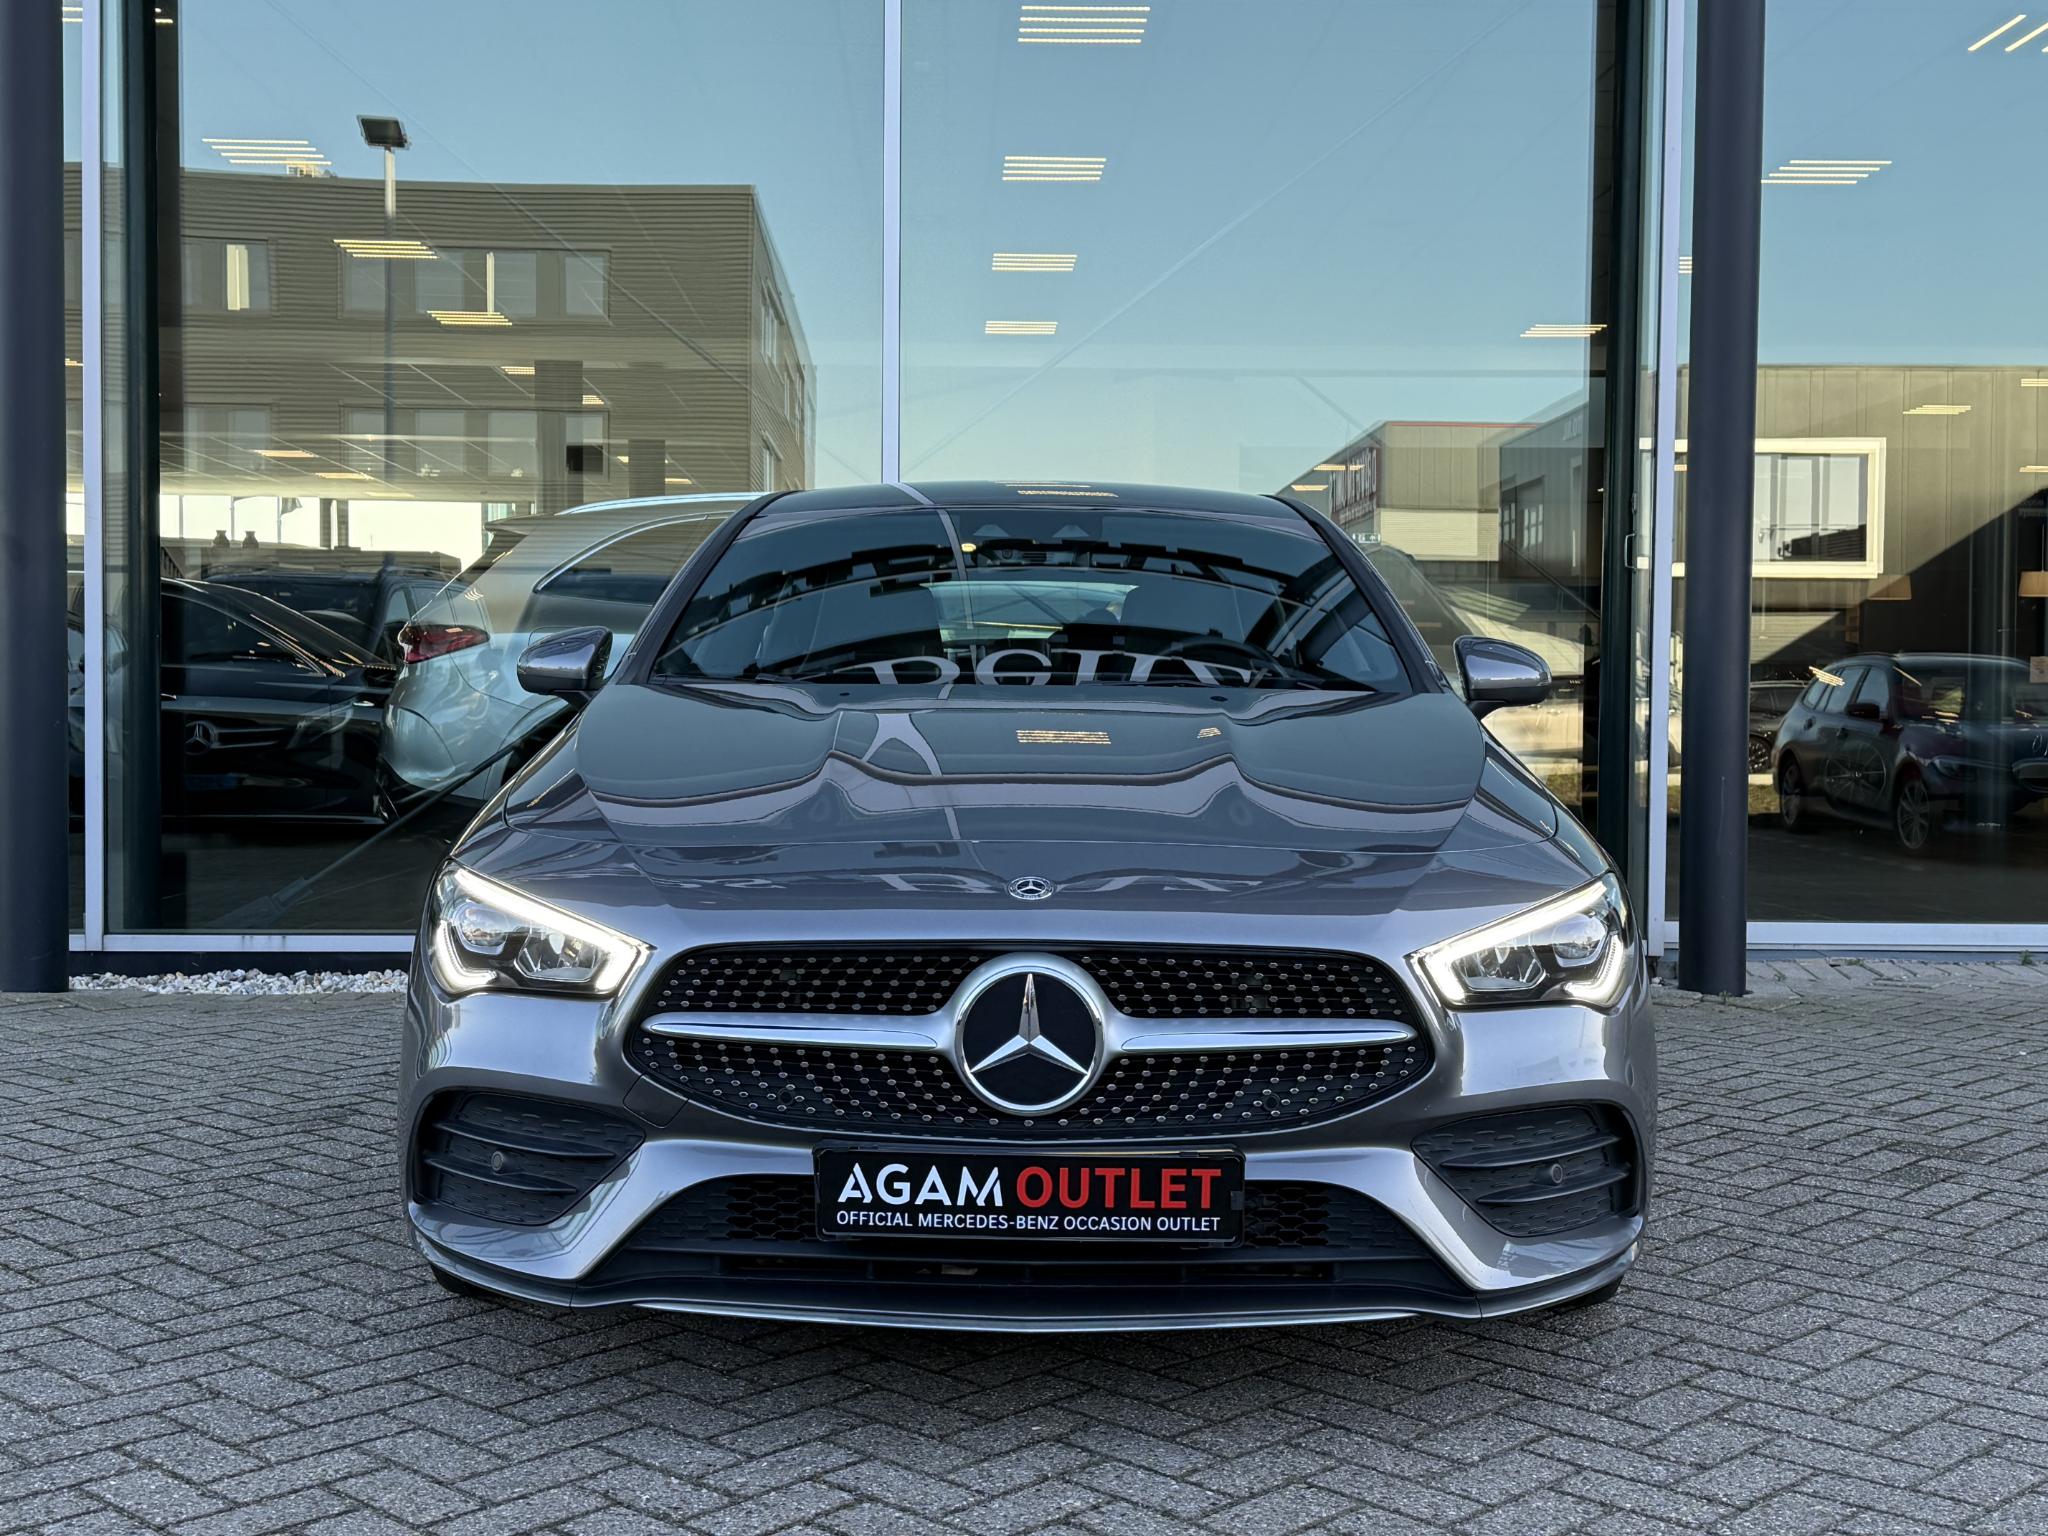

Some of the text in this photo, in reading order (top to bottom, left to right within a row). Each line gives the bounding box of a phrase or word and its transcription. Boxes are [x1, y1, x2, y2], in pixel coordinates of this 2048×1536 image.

[837, 1162, 1222, 1209] AGAM OUTLET
[836, 1210, 1221, 1231] OFFICIAL MERCEDES-BENZ OCCASION OUTLET
